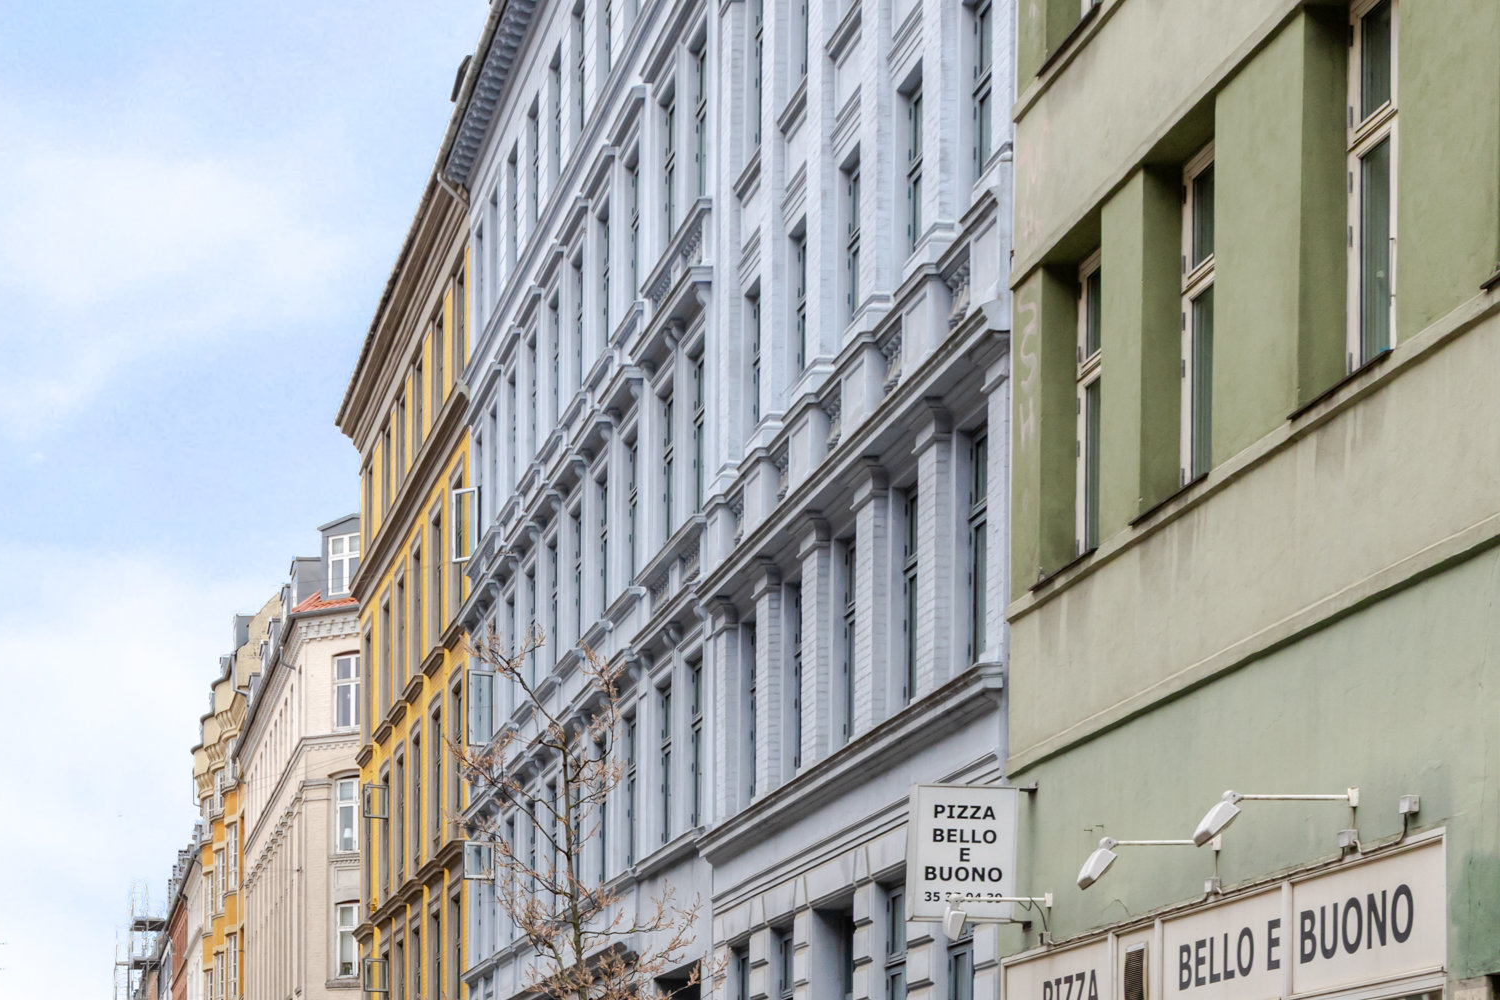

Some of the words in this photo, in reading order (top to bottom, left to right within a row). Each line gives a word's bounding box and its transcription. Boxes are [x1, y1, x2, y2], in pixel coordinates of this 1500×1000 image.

[933, 803, 996, 820] PIZZA
[932, 828, 997, 844] BELLO
[959, 847, 971, 862] E
[924, 866, 1003, 882] BUONO
[924, 891, 940, 902] 35
[1178, 926, 1255, 992] BELLO
[1266, 918, 1282, 971] E
[1299, 883, 1414, 965] BUONO
